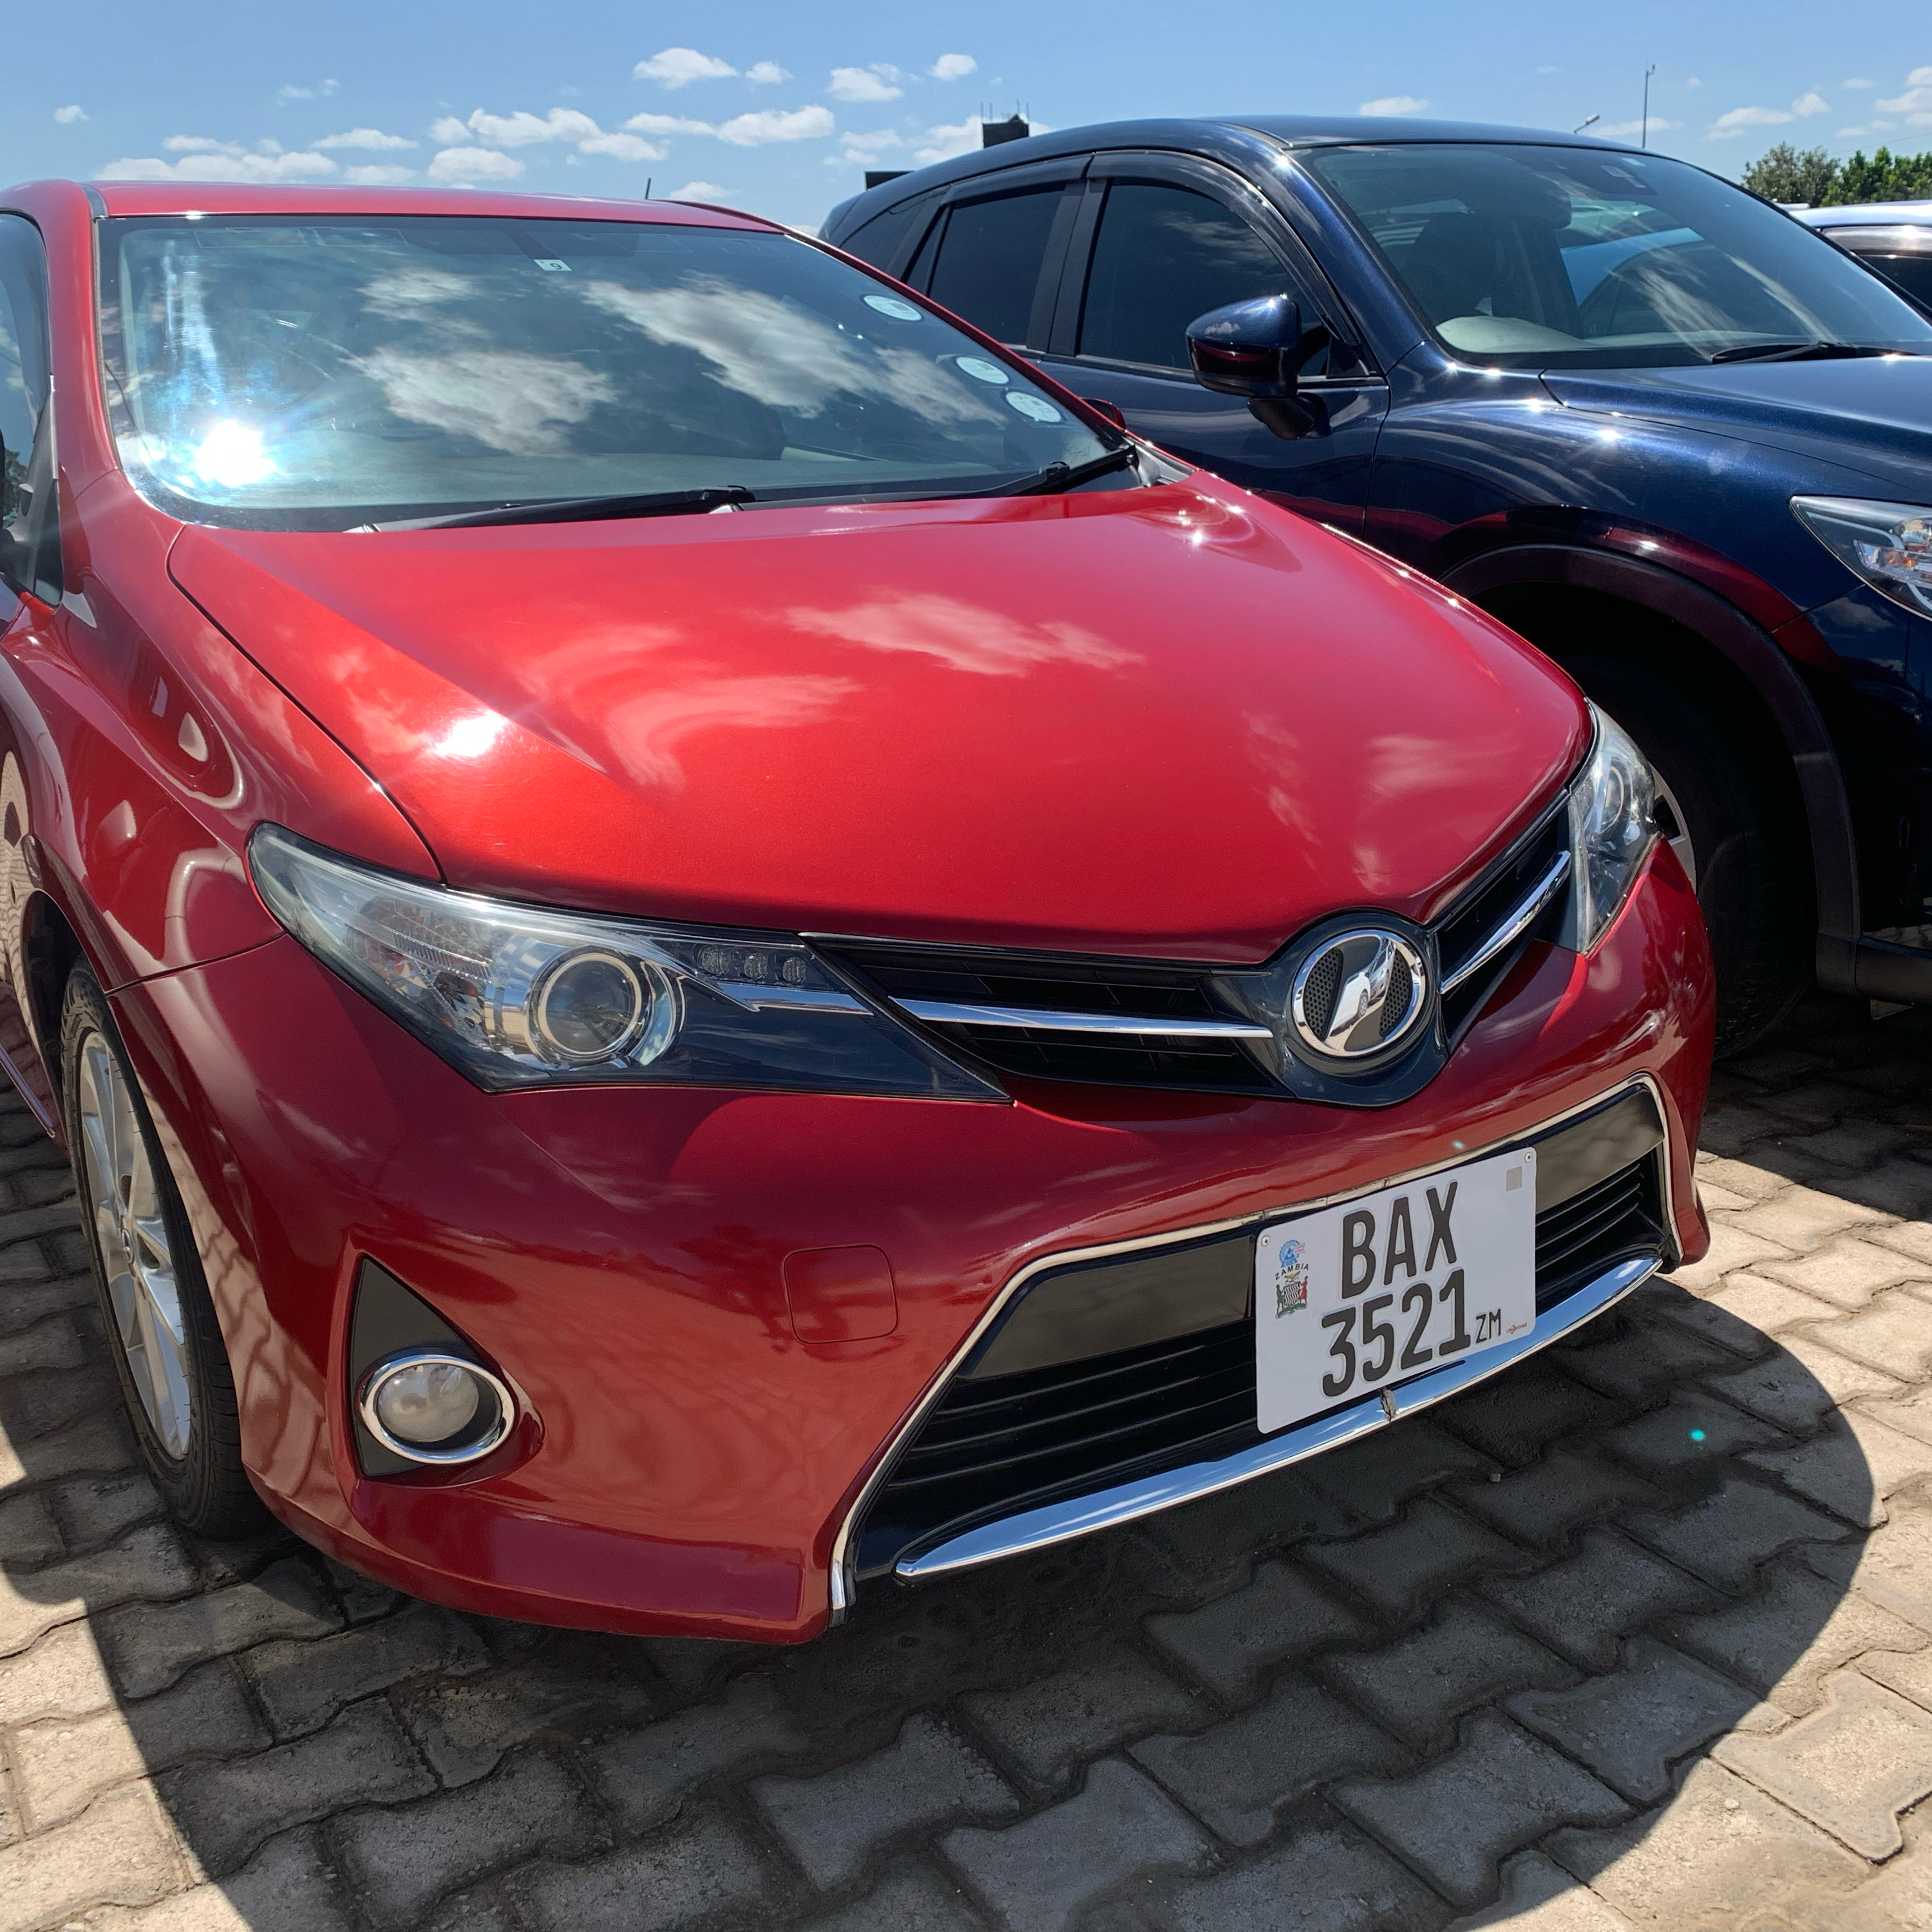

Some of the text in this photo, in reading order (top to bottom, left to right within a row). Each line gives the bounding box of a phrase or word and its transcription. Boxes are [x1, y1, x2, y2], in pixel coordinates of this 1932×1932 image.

[1274, 1263, 1309, 1281] ZAMBIA
[1341, 1181, 1458, 1300] BAX
[1321, 1269, 1501, 1397] 3521 ZM
